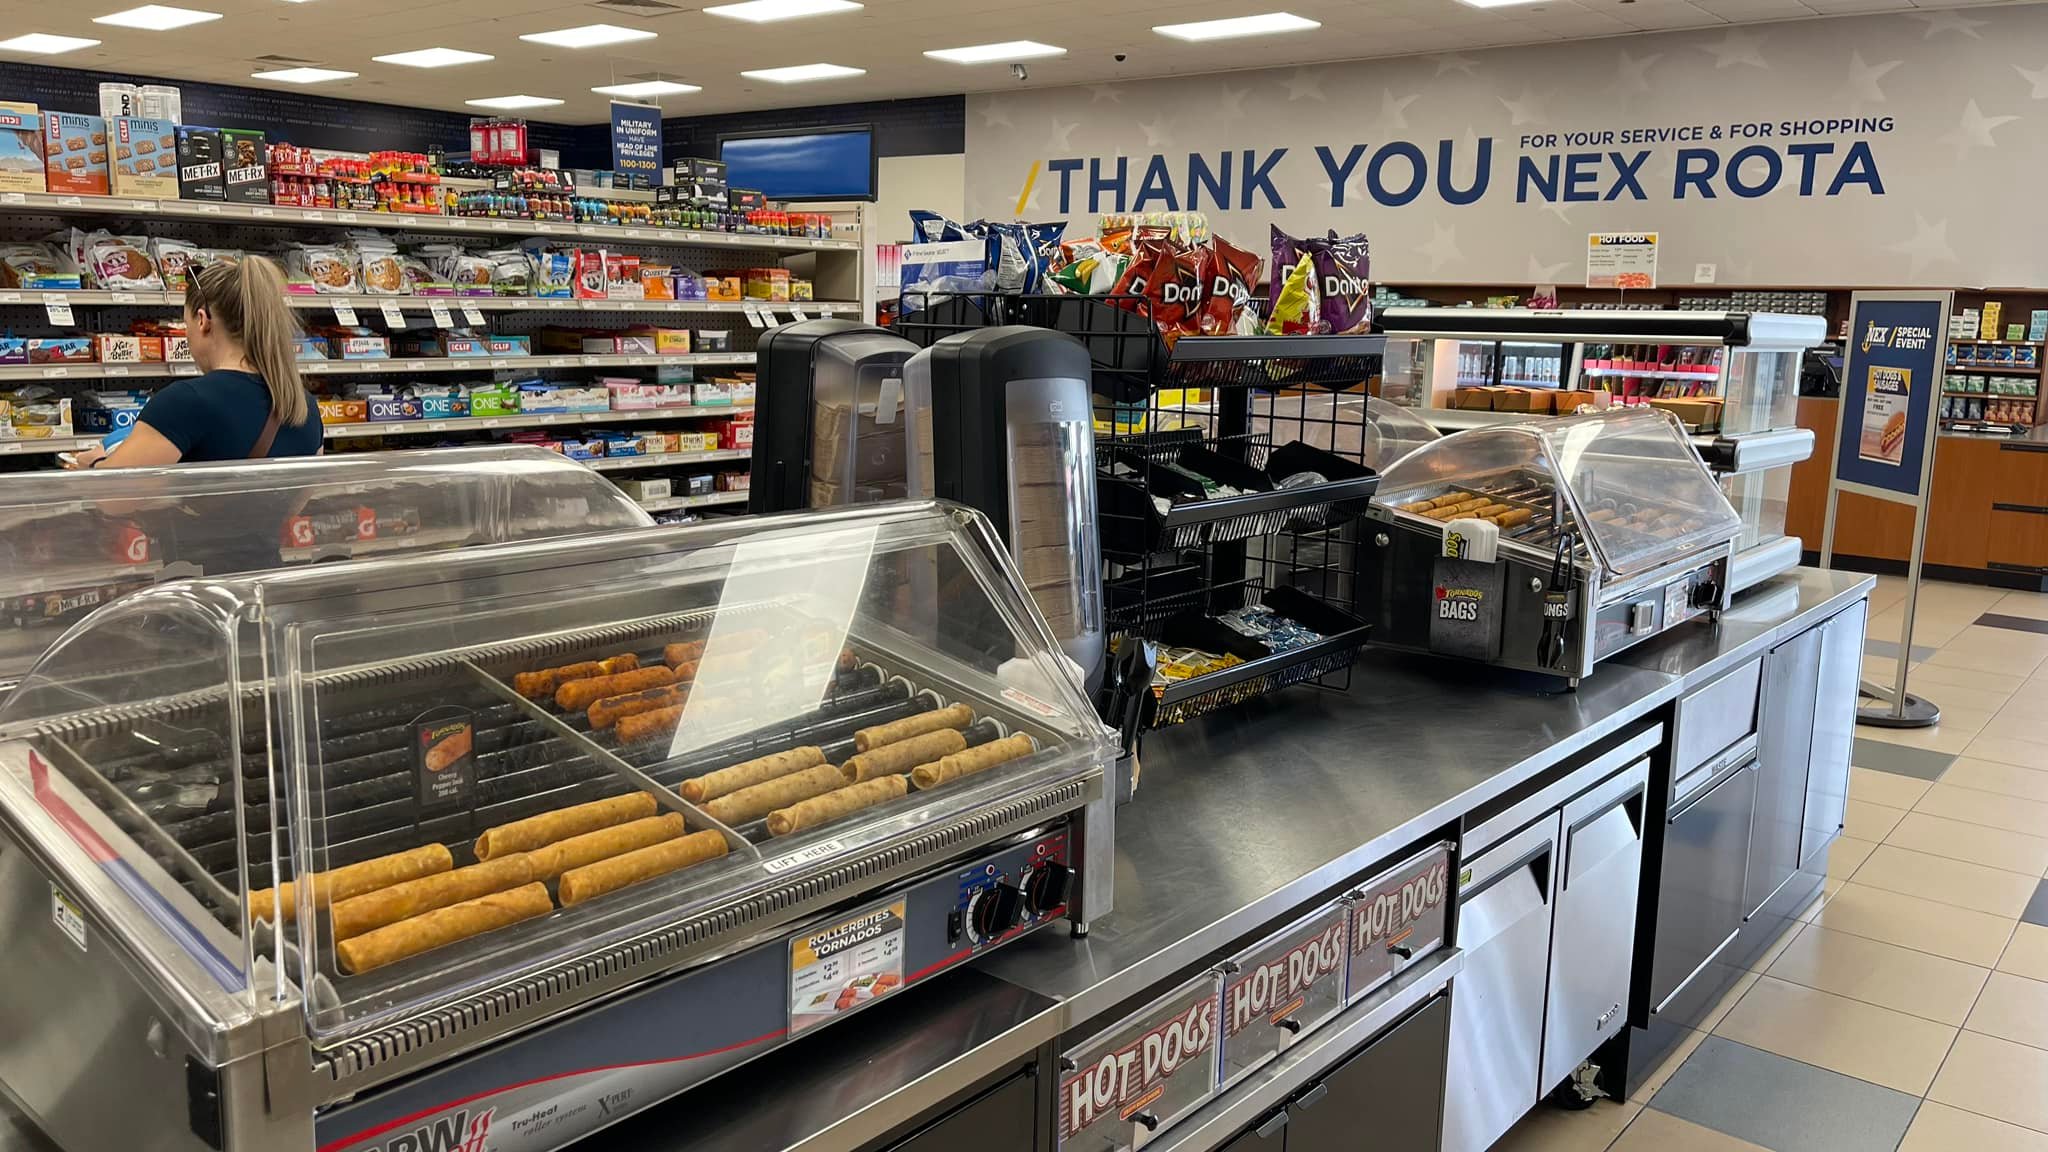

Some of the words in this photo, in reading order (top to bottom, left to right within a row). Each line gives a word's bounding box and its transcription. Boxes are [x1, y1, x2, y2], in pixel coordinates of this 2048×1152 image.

[61, 115, 90, 128] minis
[130, 119, 159, 132] minis
[620, 120, 653, 129] MILITARY
[616, 126, 624, 134] IN
[625, 127, 657, 137] UNIFORM
[1520, 134, 1558, 148] FOR
[1563, 131, 1615, 147] YOUR
[1620, 126, 1703, 144] SERVICE
[1709, 125, 1723, 140] &
[1729, 123, 1773, 139] FOR
[1779, 117, 1894, 136] SHOPPING
[616, 142, 633, 150] HEAD
[620, 148, 655, 158] PRIVILEGES
[620, 159, 657, 169] 1100-1300
[1048, 147, 1289, 214] THANK
[1314, 137, 1493, 208] YOU
[1516, 150, 1652, 203] NEX
[1673, 141, 1886, 200] ROTA
[1599, 235, 1617, 244] HOT
[1619, 234, 1646, 243] FOOD
[1866, 327, 1889, 343] NEX
[1897, 327, 1932, 338] SPECIAL
[453, 343, 471, 352] CLIF
[493, 343, 510, 351] CLIF
[1895, 338, 1926, 349] EVENT!
[372, 402, 401, 417] ONE
[422, 398, 450, 413] ONE
[472, 396, 500, 410] ONE
[358, 517, 375, 537] G
[127, 533, 147, 561] G
[1445, 588, 1484, 600] TORNADOS
[1439, 599, 1478, 621] BAGS
[770, 856, 798, 870] LIFT
[801, 843, 838, 858] HERE
[1357, 893, 1399, 953] HOT
[1400, 863, 1445, 927] DOGS
[808, 909, 890, 948] ROLLERBITES
[814, 924, 882, 957] TORNADOS
[1231, 965, 1284, 1032] HOT
[1287, 925, 1343, 995] DOGS
[1070, 1049, 1137, 1135] HOT
[1141, 1001, 1212, 1087] DOGS
[512, 1104, 558, 1131] Tru-Heat
